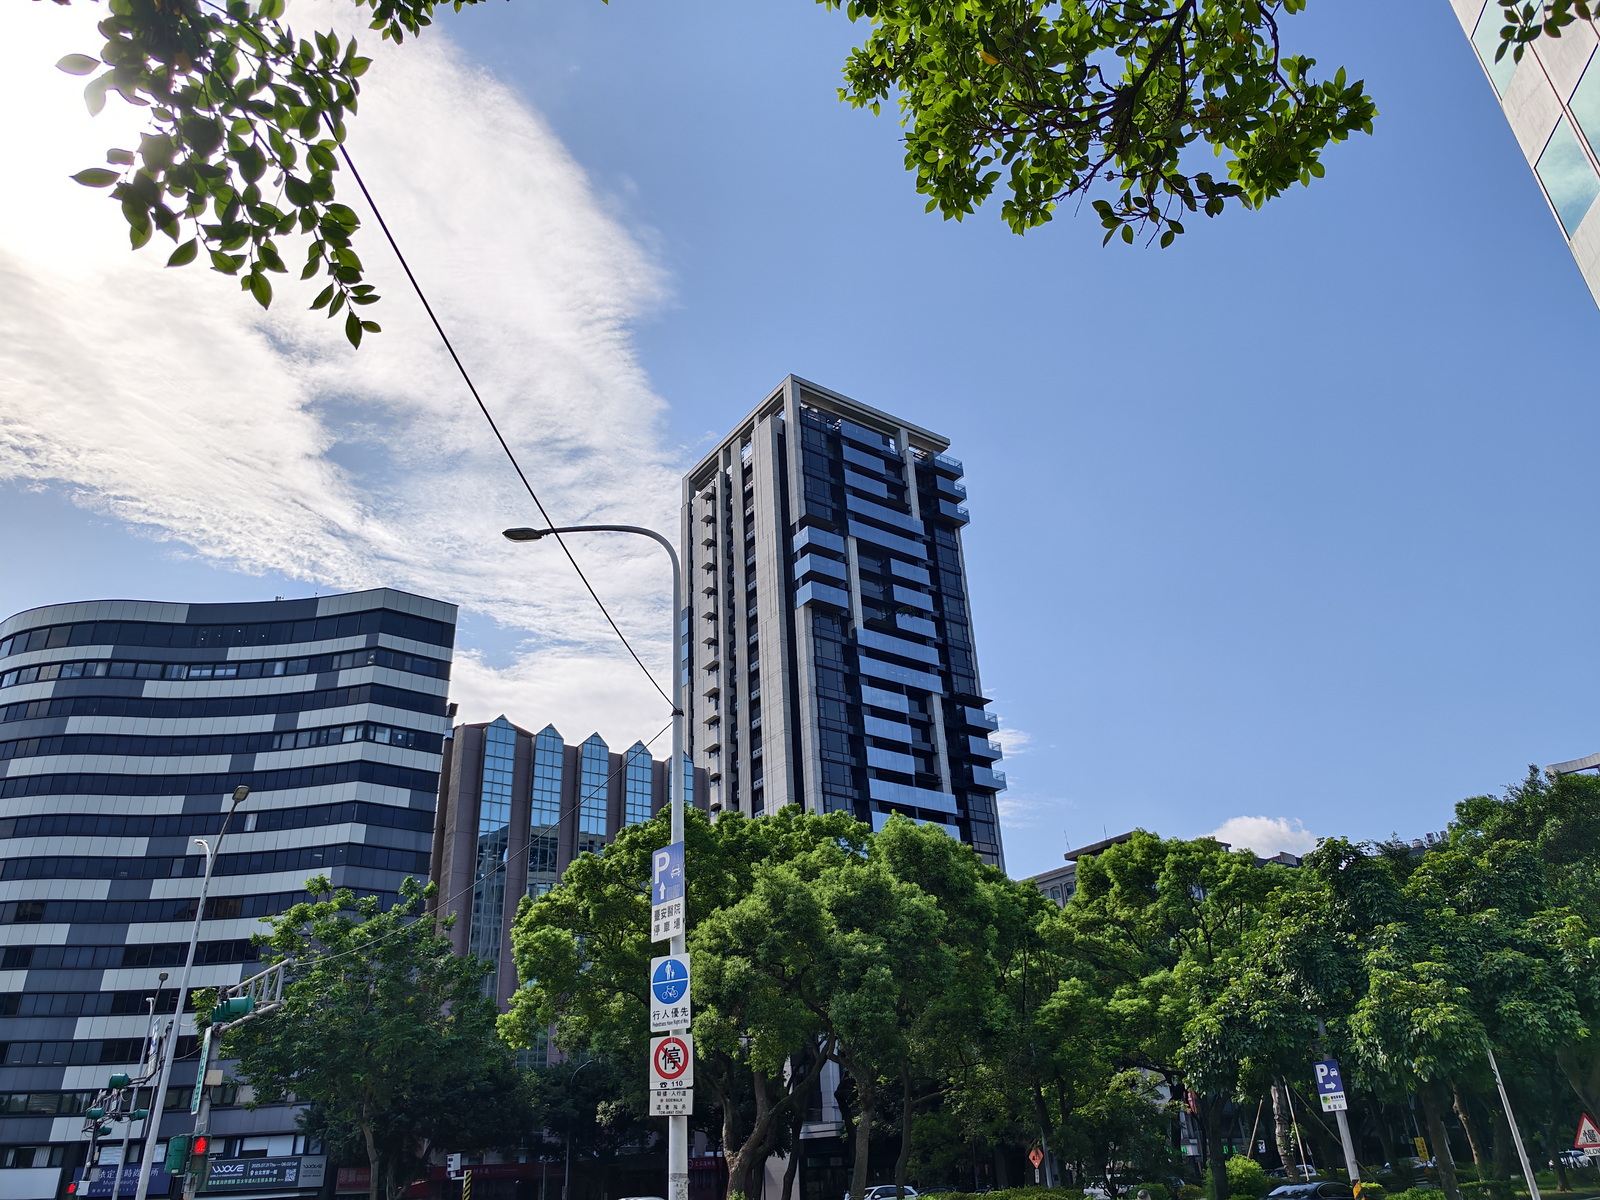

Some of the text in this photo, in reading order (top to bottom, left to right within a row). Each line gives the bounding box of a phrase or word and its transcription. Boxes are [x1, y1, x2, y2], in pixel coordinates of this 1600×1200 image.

[655, 852, 670, 884] P
[654, 903, 681, 922] 臺安醫院
[653, 917, 681, 936] 停車場
[652, 1006, 689, 1021] 行人優先
[662, 1046, 681, 1070] 停
[1315, 1064, 1328, 1083] P
